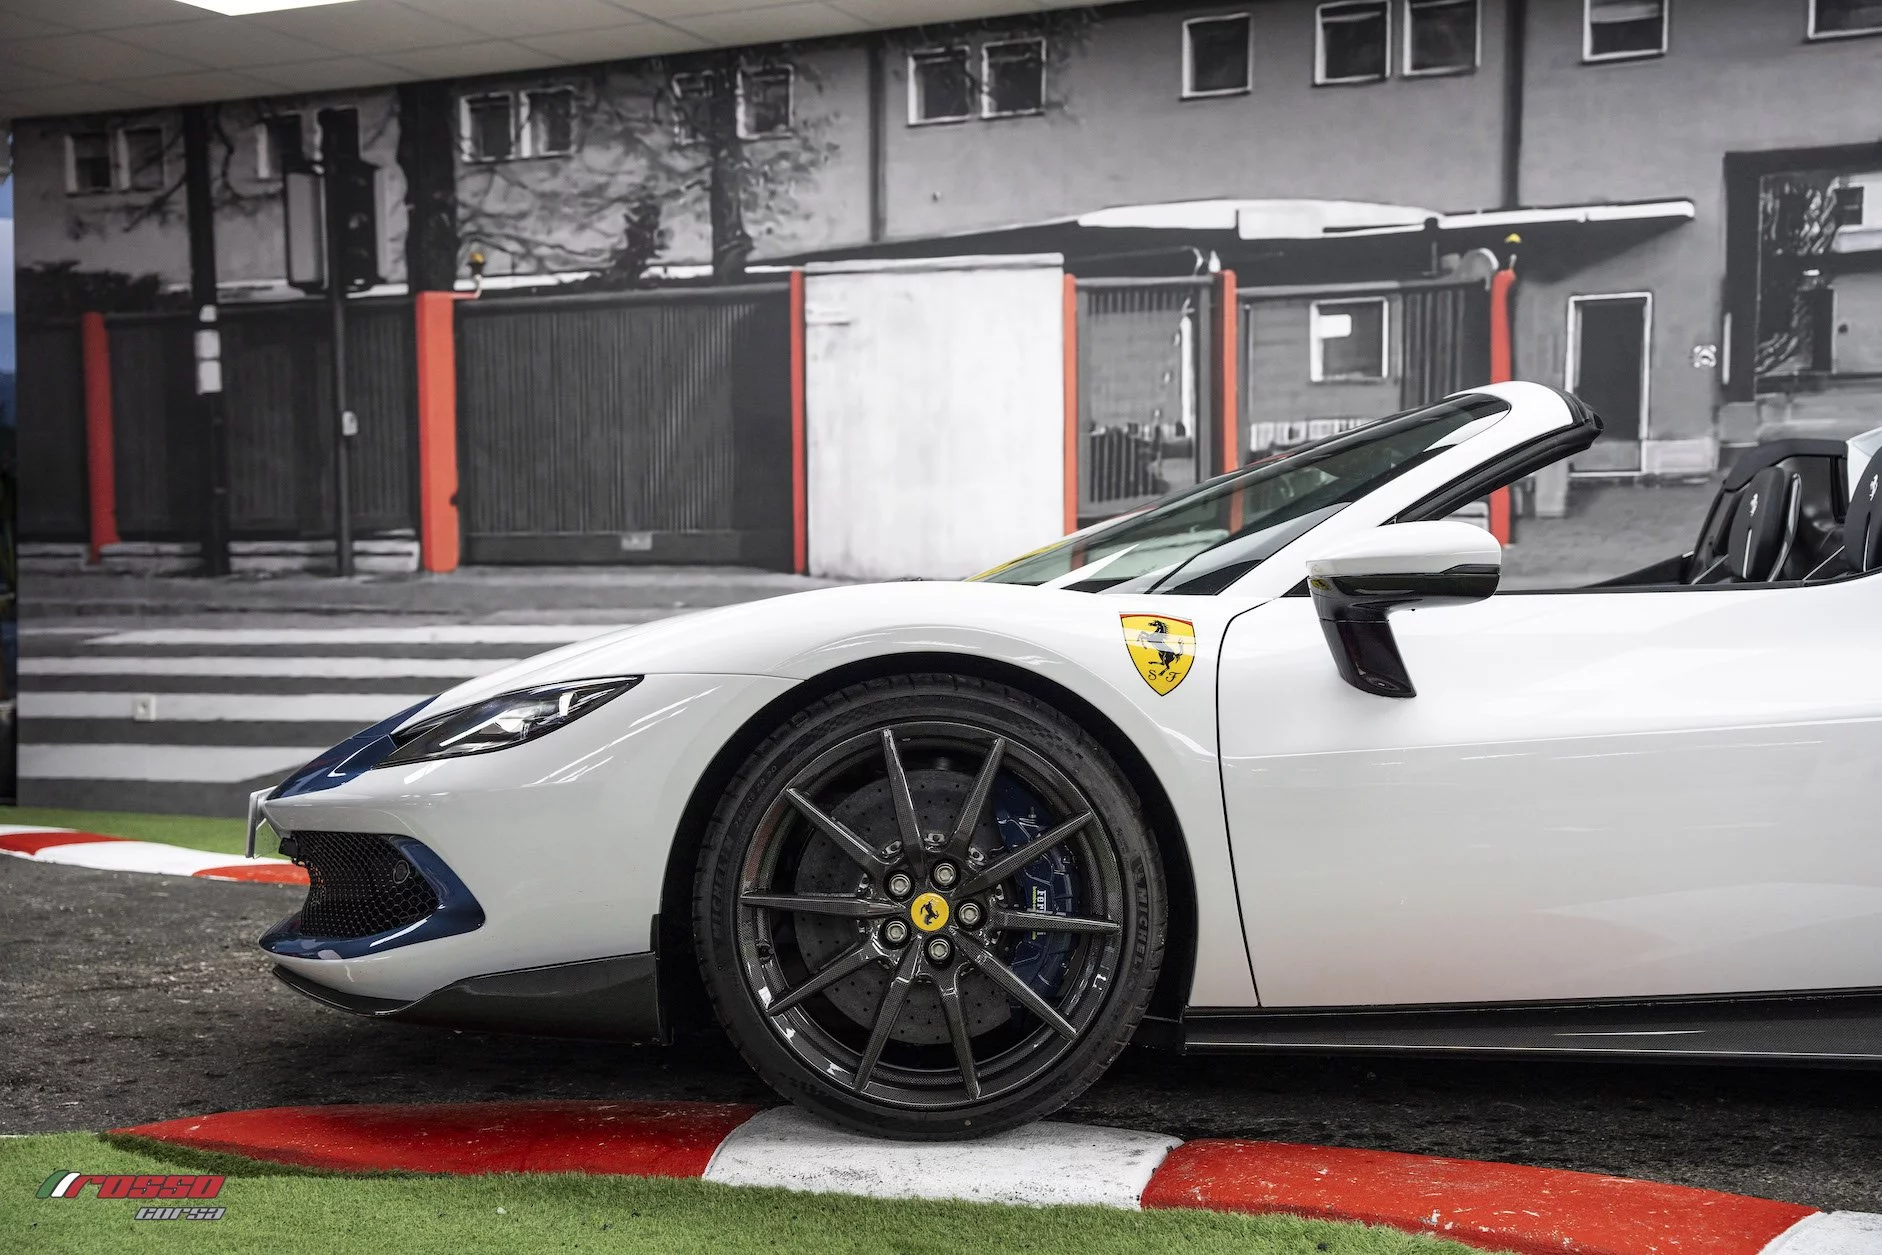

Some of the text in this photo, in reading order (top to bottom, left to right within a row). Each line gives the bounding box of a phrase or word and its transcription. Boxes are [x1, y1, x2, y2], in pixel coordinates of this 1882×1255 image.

[1148, 669, 1182, 683] S F
[1126, 886, 1149, 991] MICHELIN
